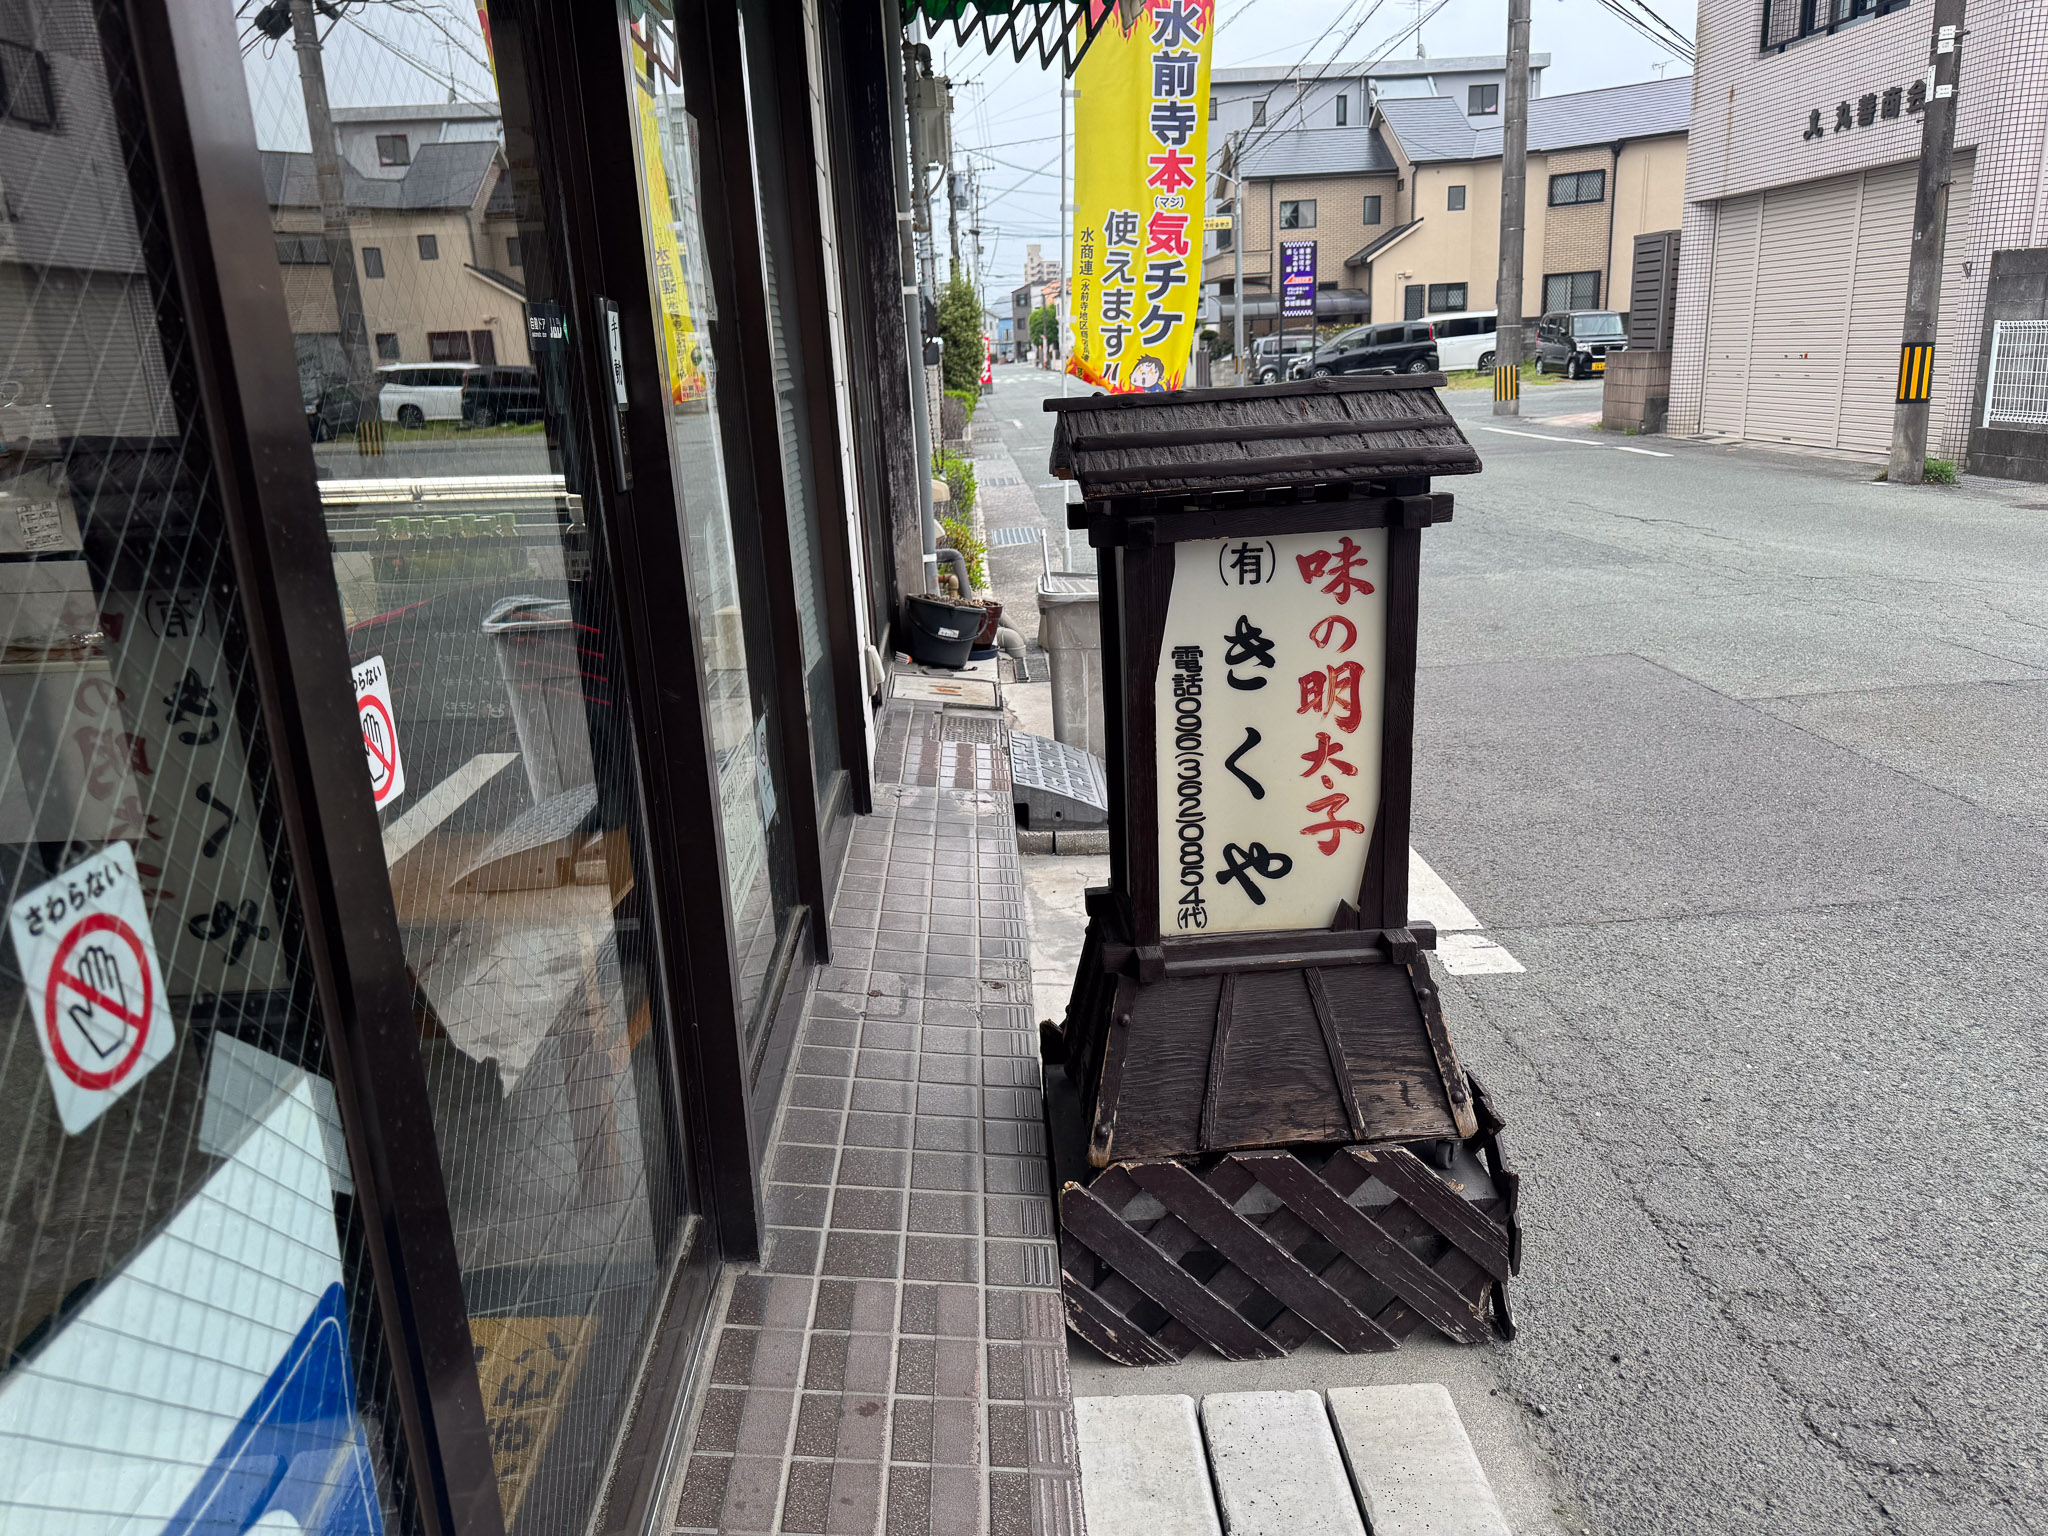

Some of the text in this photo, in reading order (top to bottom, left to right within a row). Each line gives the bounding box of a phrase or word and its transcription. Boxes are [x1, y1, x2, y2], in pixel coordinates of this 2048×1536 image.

[1834, 79, 1926, 132] 丸善商会
[1296, 536, 1375, 857] 味の明太子
[25, 859, 123, 937] さわらない
